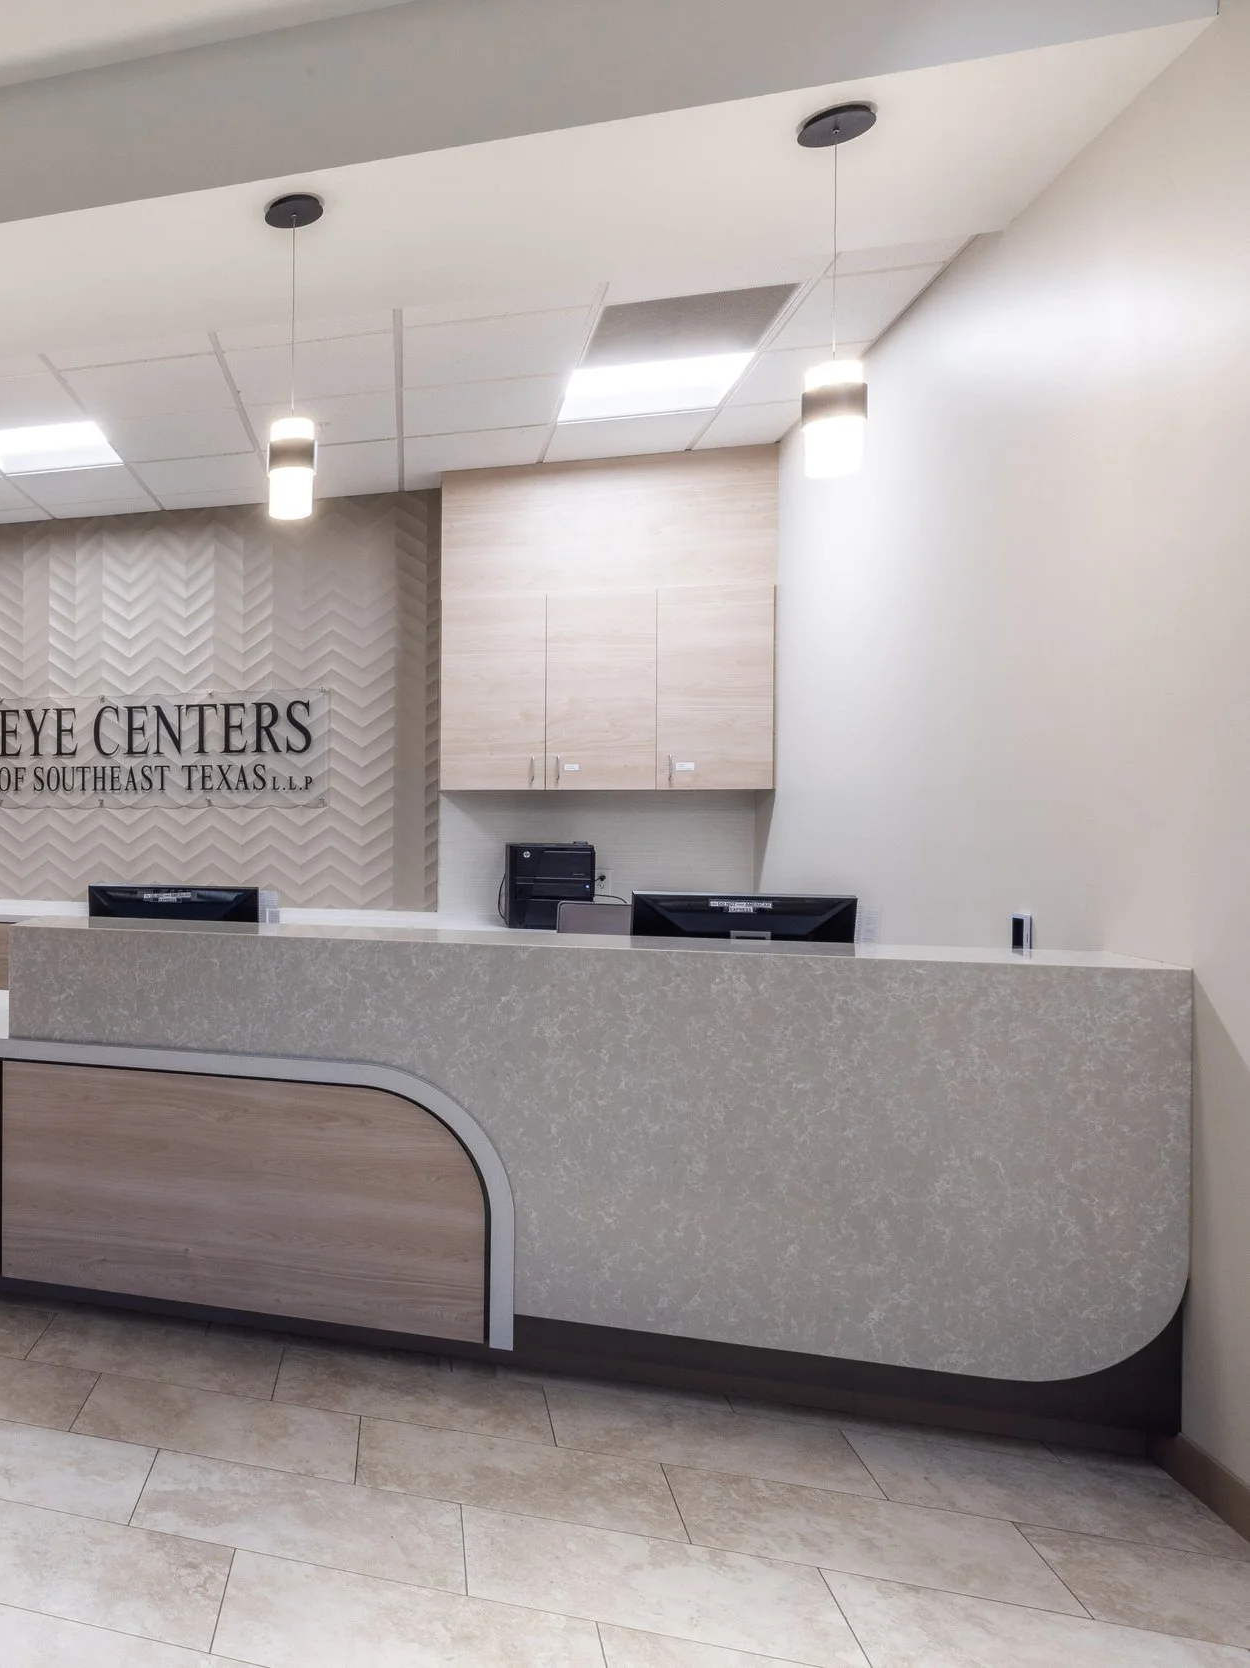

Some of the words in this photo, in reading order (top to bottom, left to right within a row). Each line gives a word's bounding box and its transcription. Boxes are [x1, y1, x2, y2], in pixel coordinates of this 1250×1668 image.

[93, 699, 312, 756] CENTERS
[33, 764, 171, 792] SOUTHEAST
[181, 763, 267, 791] TEXAS
